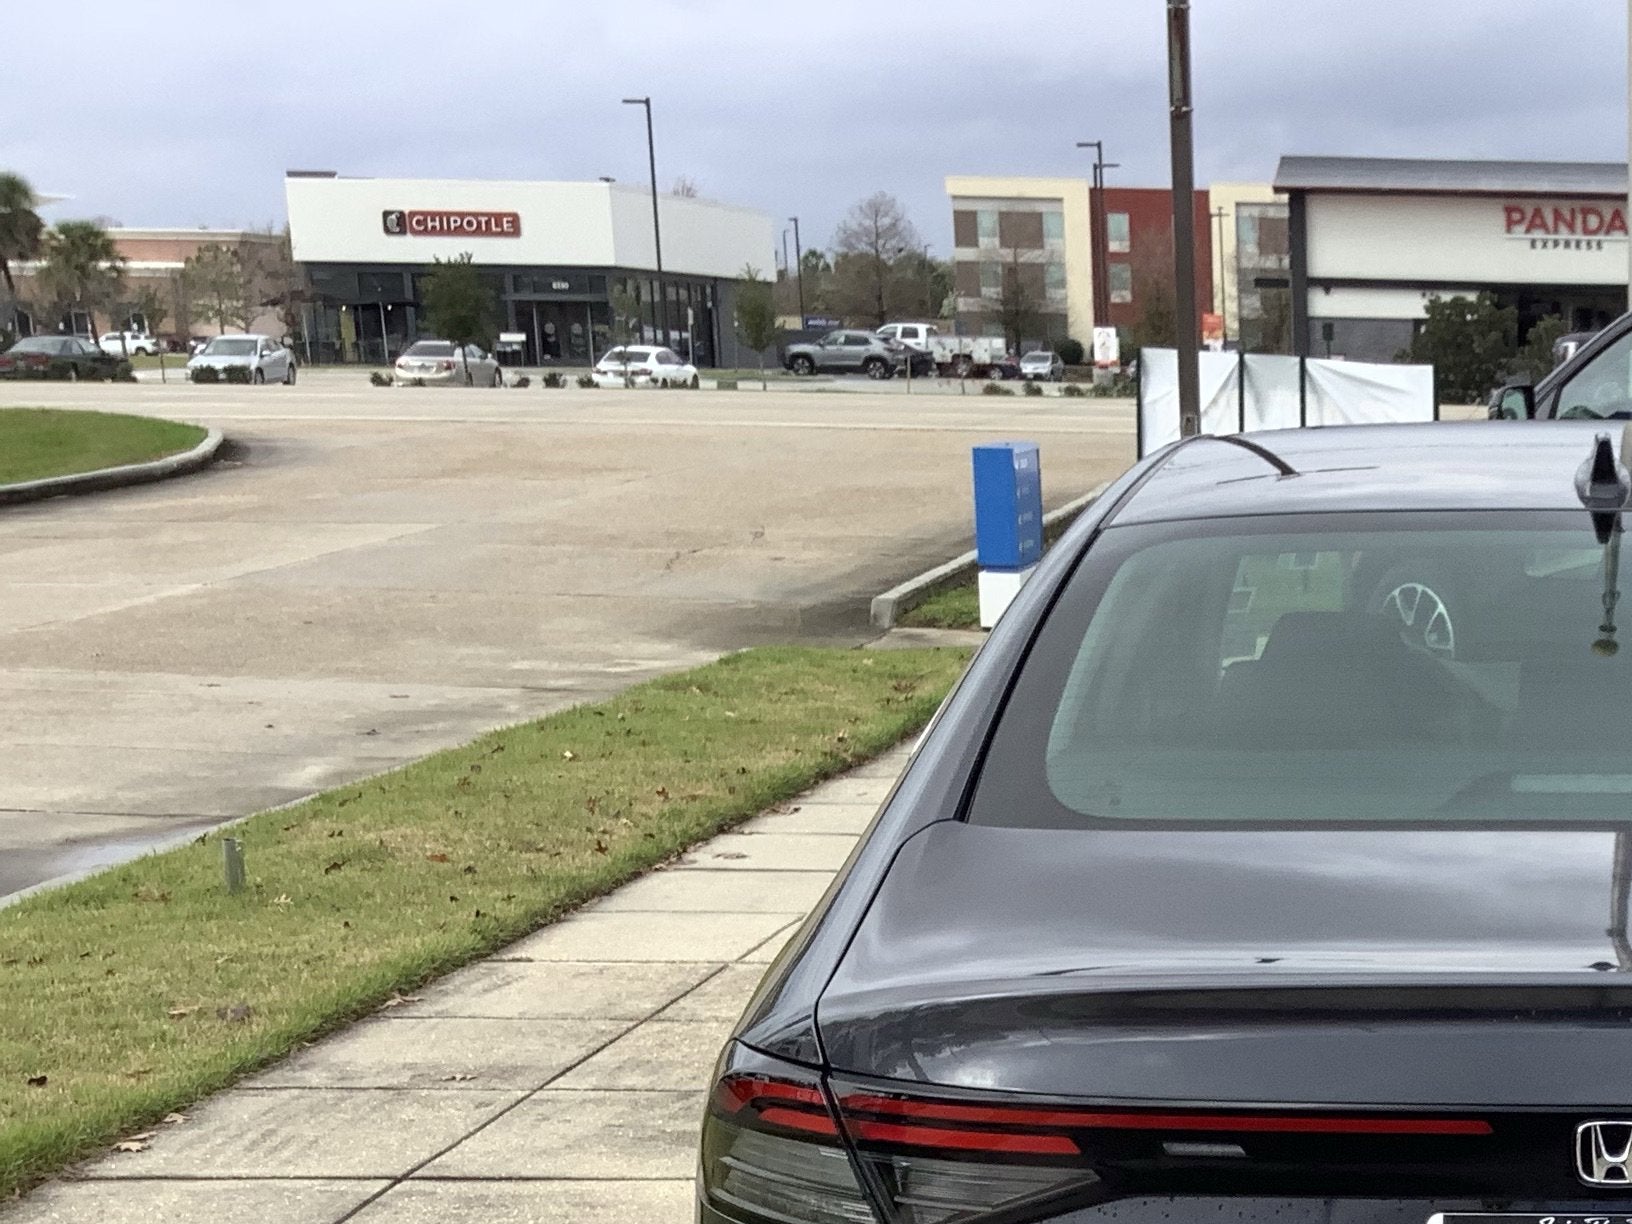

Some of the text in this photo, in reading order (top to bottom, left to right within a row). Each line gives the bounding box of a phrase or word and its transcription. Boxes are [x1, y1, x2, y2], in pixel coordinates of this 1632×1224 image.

[412, 215, 514, 232] CHIPOTLE
[1504, 205, 1628, 235] PANDA
[1530, 238, 1603, 250] EXPRESS
